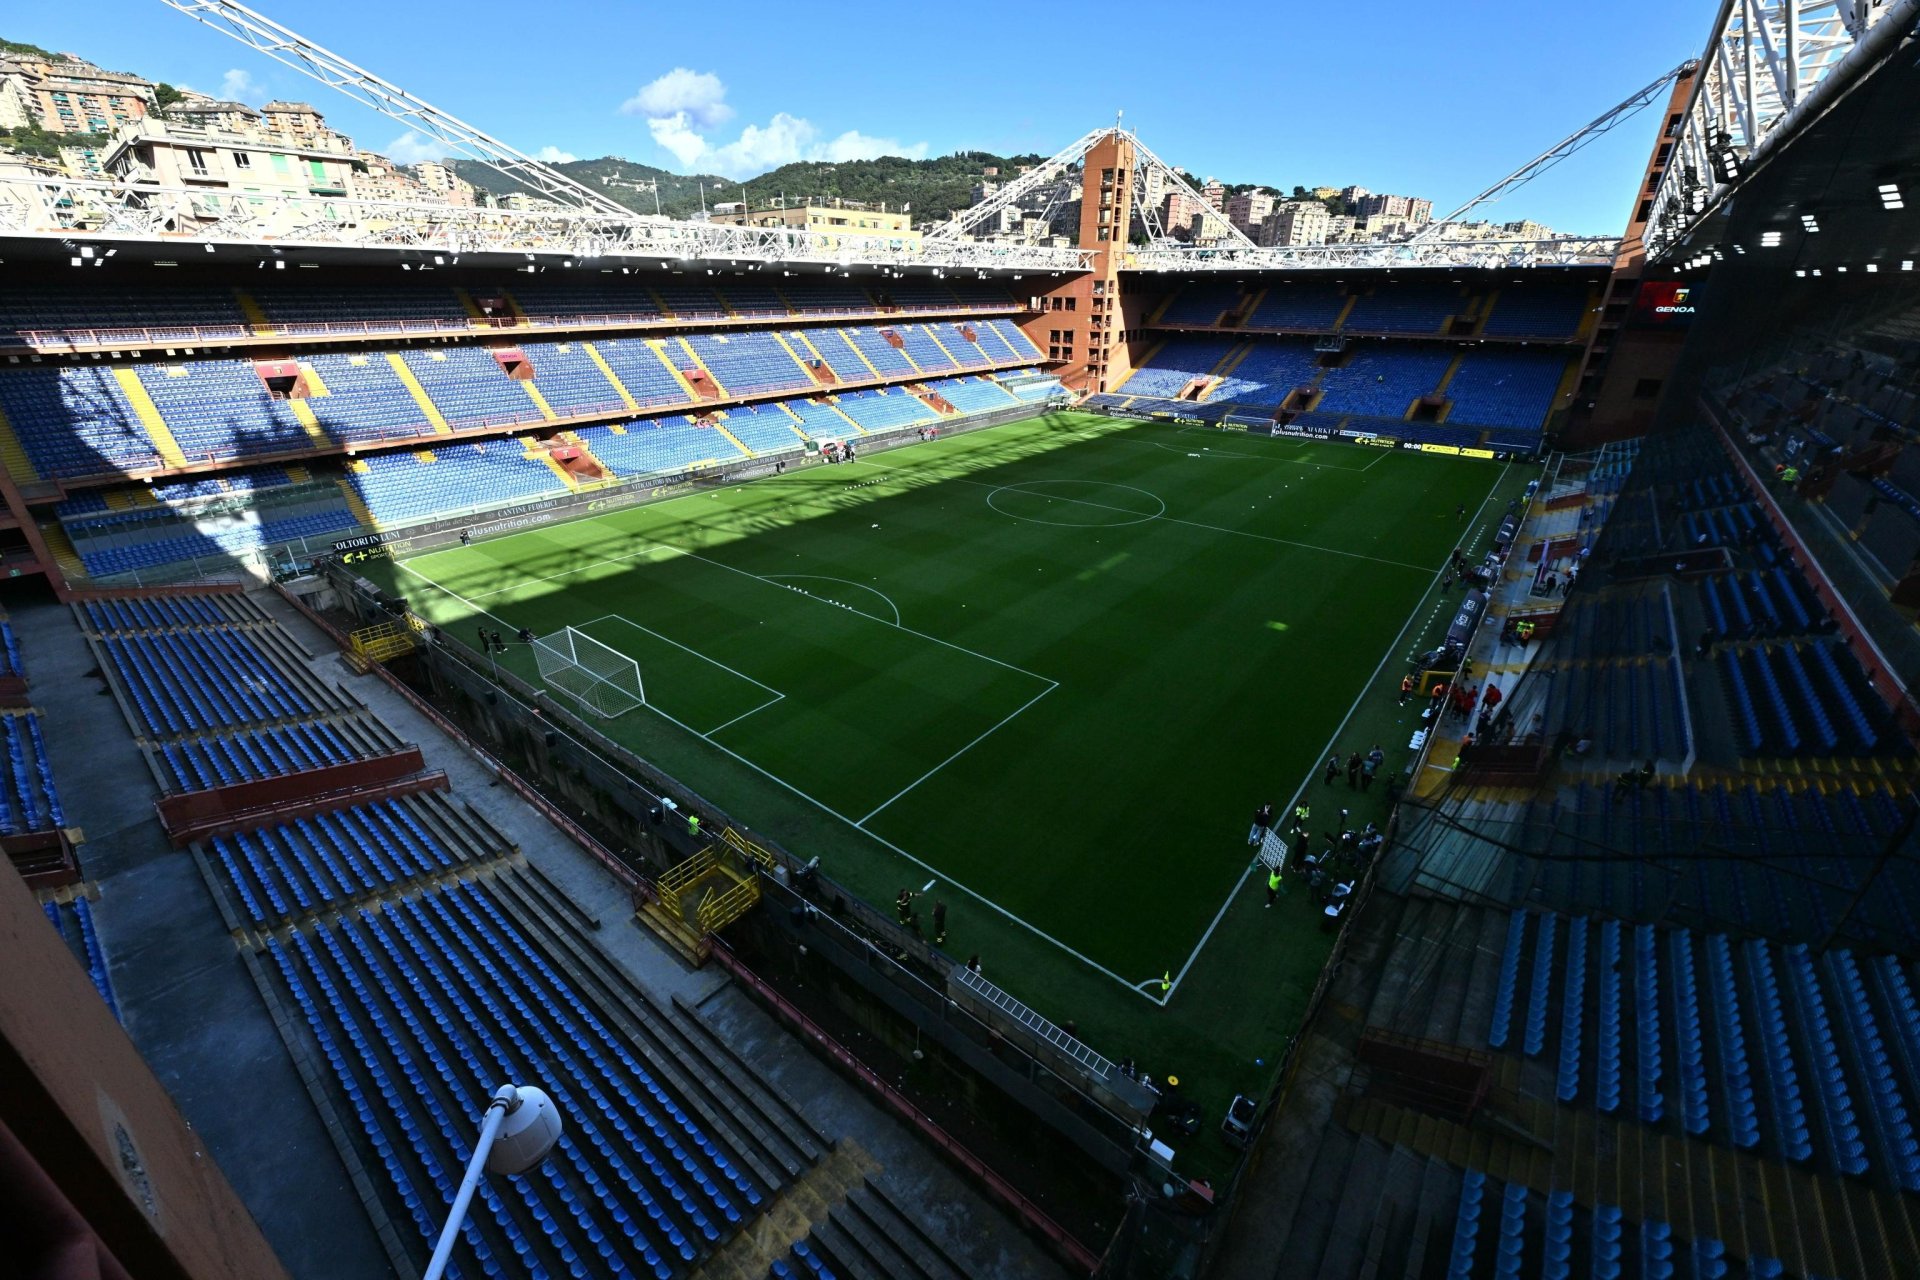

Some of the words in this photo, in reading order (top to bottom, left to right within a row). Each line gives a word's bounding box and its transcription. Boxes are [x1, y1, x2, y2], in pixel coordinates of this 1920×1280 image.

[497, 505, 527, 518] CANTINE
[527, 499, 558, 512] FEDERICI
[369, 534, 380, 545] IN
[380, 530, 401, 543] LUNI
